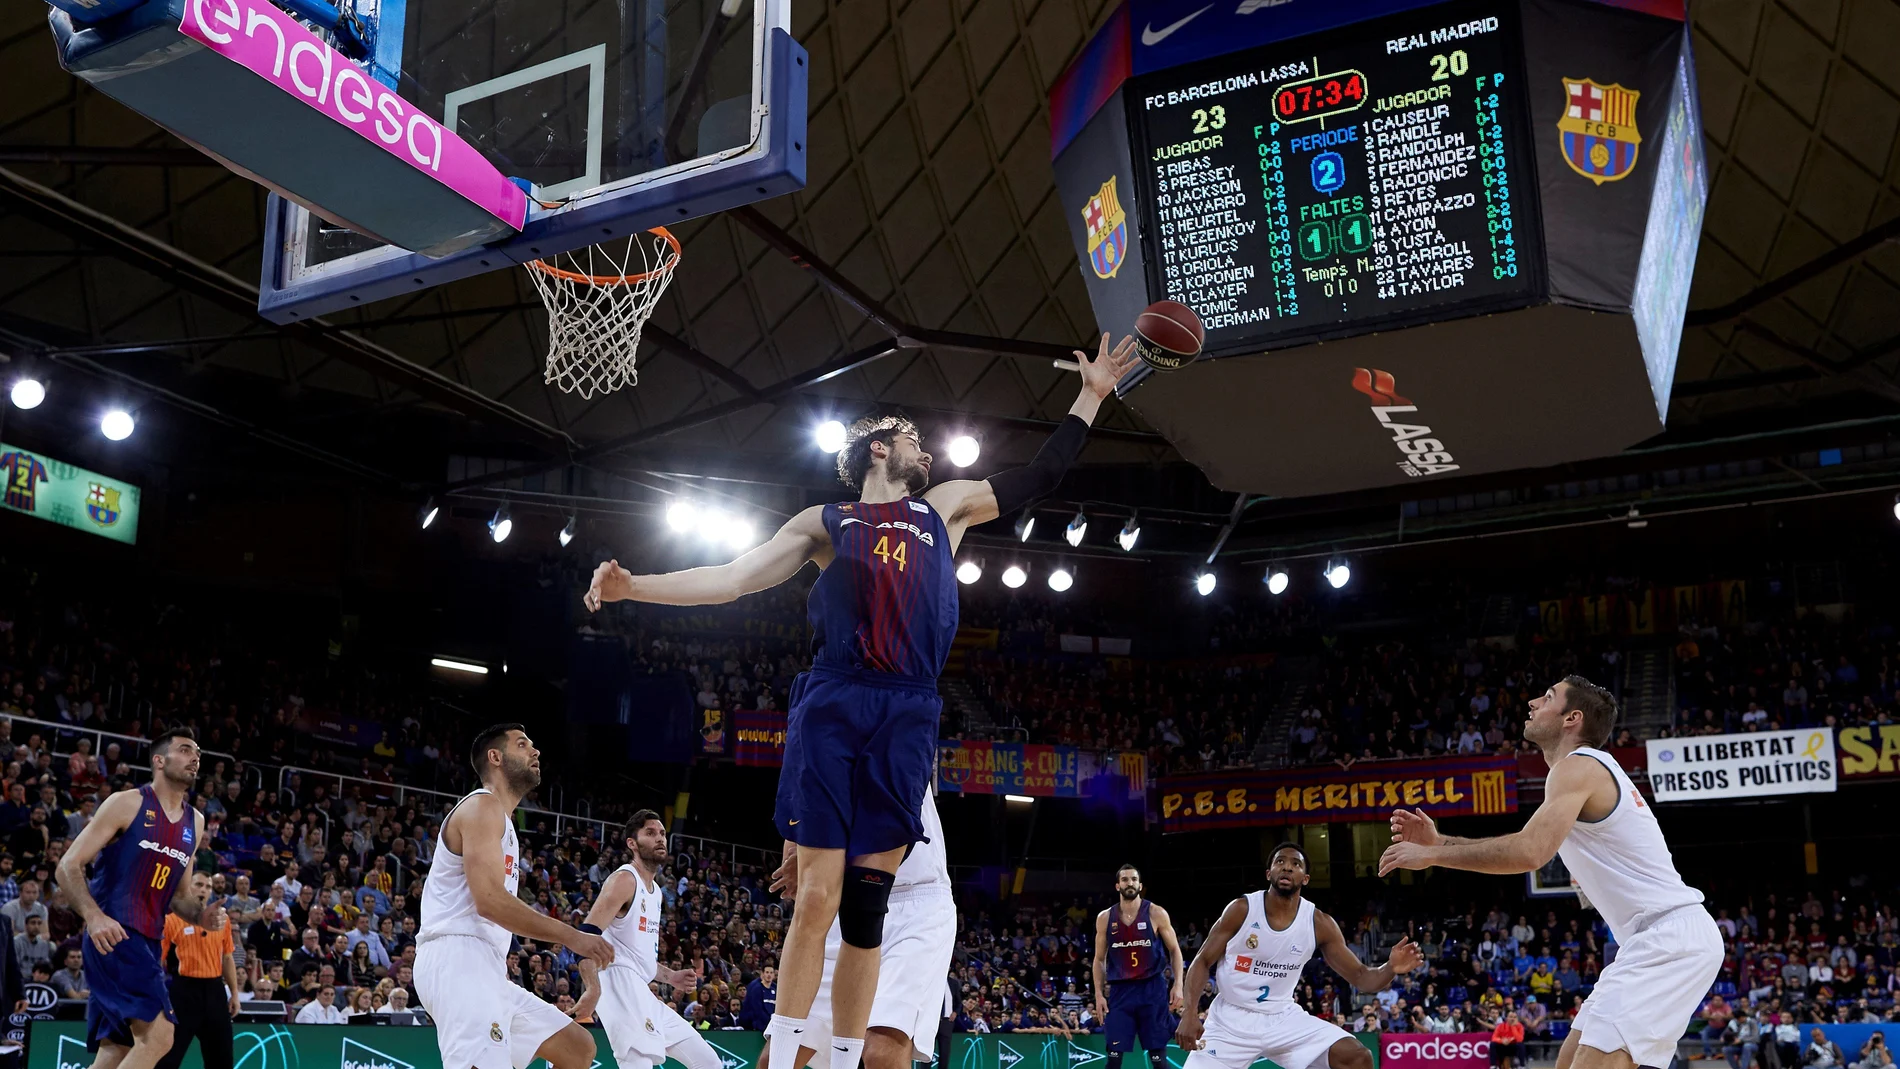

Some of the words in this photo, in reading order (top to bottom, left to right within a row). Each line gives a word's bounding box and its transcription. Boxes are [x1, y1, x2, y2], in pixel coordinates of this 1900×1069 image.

[1386, 33, 1428, 55] REAL
[1430, 16, 1499, 45] MADRID
[1429, 49, 1469, 82] 20
[194, 0, 442, 172] endesa
[1145, 95, 1166, 110] FC
[1167, 73, 1258, 105] BARCELONA
[1261, 61, 1309, 83] LASSA
[1279, 75, 1363, 115] 07:34
[1372, 84, 1452, 114] JUGADOR
[1475, 76, 1486, 92] F
[1493, 72, 1505, 88] P
[1191, 104, 1226, 134] 23
[1363, 121, 1369, 134] 1
[1372, 104, 1450, 133] CAUSEUR
[1152, 134, 1223, 161] JUGADOR
[1253, 125, 1263, 139] F
[1270, 122, 1280, 136] P
[1290, 126, 1359, 154] PERIODE
[1364, 136, 1375, 150] 2
[1377, 121, 1442, 147] RANDLE
[1366, 150, 1376, 165] 3
[1378, 132, 1465, 162] RANDOLPH
[1156, 166, 1165, 179] 5
[1167, 156, 1211, 177] RIBAS
[1317, 159, 1337, 186] 2
[1367, 165, 1376, 180] 5
[1379, 145, 1476, 178] FERNANDEZ
[1158, 180, 1168, 193] 8
[1170, 165, 1235, 190] PRESSEY
[1369, 181, 1380, 194] 6
[1382, 163, 1468, 192] RADONCIC
[1157, 194, 1171, 207] 10
[1174, 179, 1242, 204] JACKSON
[1371, 196, 1381, 209] 9
[1384, 184, 1437, 207] REYES
[1159, 208, 1170, 222] 11
[1172, 193, 1247, 219] NAVARRO
[1300, 195, 1364, 222] FALTES
[1369, 210, 1381, 225] 11
[1384, 192, 1475, 222] CAMPAZZO
[1160, 222, 1175, 236] 13
[1177, 209, 1241, 233] HEURTEL
[1162, 236, 1176, 250] 14
[1179, 220, 1256, 246] VEZENKOV
[1307, 228, 1322, 253] 1
[1347, 220, 1363, 246] 1
[1372, 225, 1386, 240] 14
[1390, 215, 1436, 237] AYON
[1163, 251, 1176, 264] 17
[1179, 239, 1239, 262] KURUCS
[1372, 240, 1388, 255] 16
[1391, 230, 1446, 251] YUSTA
[1374, 255, 1393, 271] 20
[1396, 240, 1471, 266] CARROLL
[1165, 265, 1179, 279] 18
[1182, 255, 1235, 275] ORIOLA
[1167, 279, 1183, 293] 25
[1186, 265, 1255, 290] KOPONEN
[1376, 270, 1396, 285] 22
[1396, 256, 1475, 281] TAVARES
[1189, 282, 1247, 303] CLAVER
[1377, 285, 1397, 299] 44
[1398, 272, 1465, 296] TAYLOR
[1201, 307, 1270, 330] OERMAN
[1371, 405, 1460, 475] LASSA
[16, 466, 29, 488] 2
[874, 521, 934, 544] ASSA
[873, 535, 907, 572] 44
[703, 709, 721, 725] 15
[974, 749, 1018, 773] SANG
[1038, 751, 1075, 775] CULÉ
[1684, 736, 1795, 763] LLIBERTAT
[1838, 724, 1900, 775] SA
[1652, 770, 1729, 793] PRESOS
[1739, 760, 1831, 787] POLÍTICS
[1162, 788, 1257, 819] P.B.B.
[1275, 777, 1464, 812] MERITXELL
[155, 842, 190, 864] LASSA
[151, 863, 171, 890] 18
[1121, 939, 1151, 948] LASSA
[1131, 951, 1139, 967] 5
[1253, 968, 1287, 979] Europea
[26, 989, 50, 1005] KIA
[1256, 985, 1270, 1003] 2
[1386, 1037, 1491, 1060] endesa
